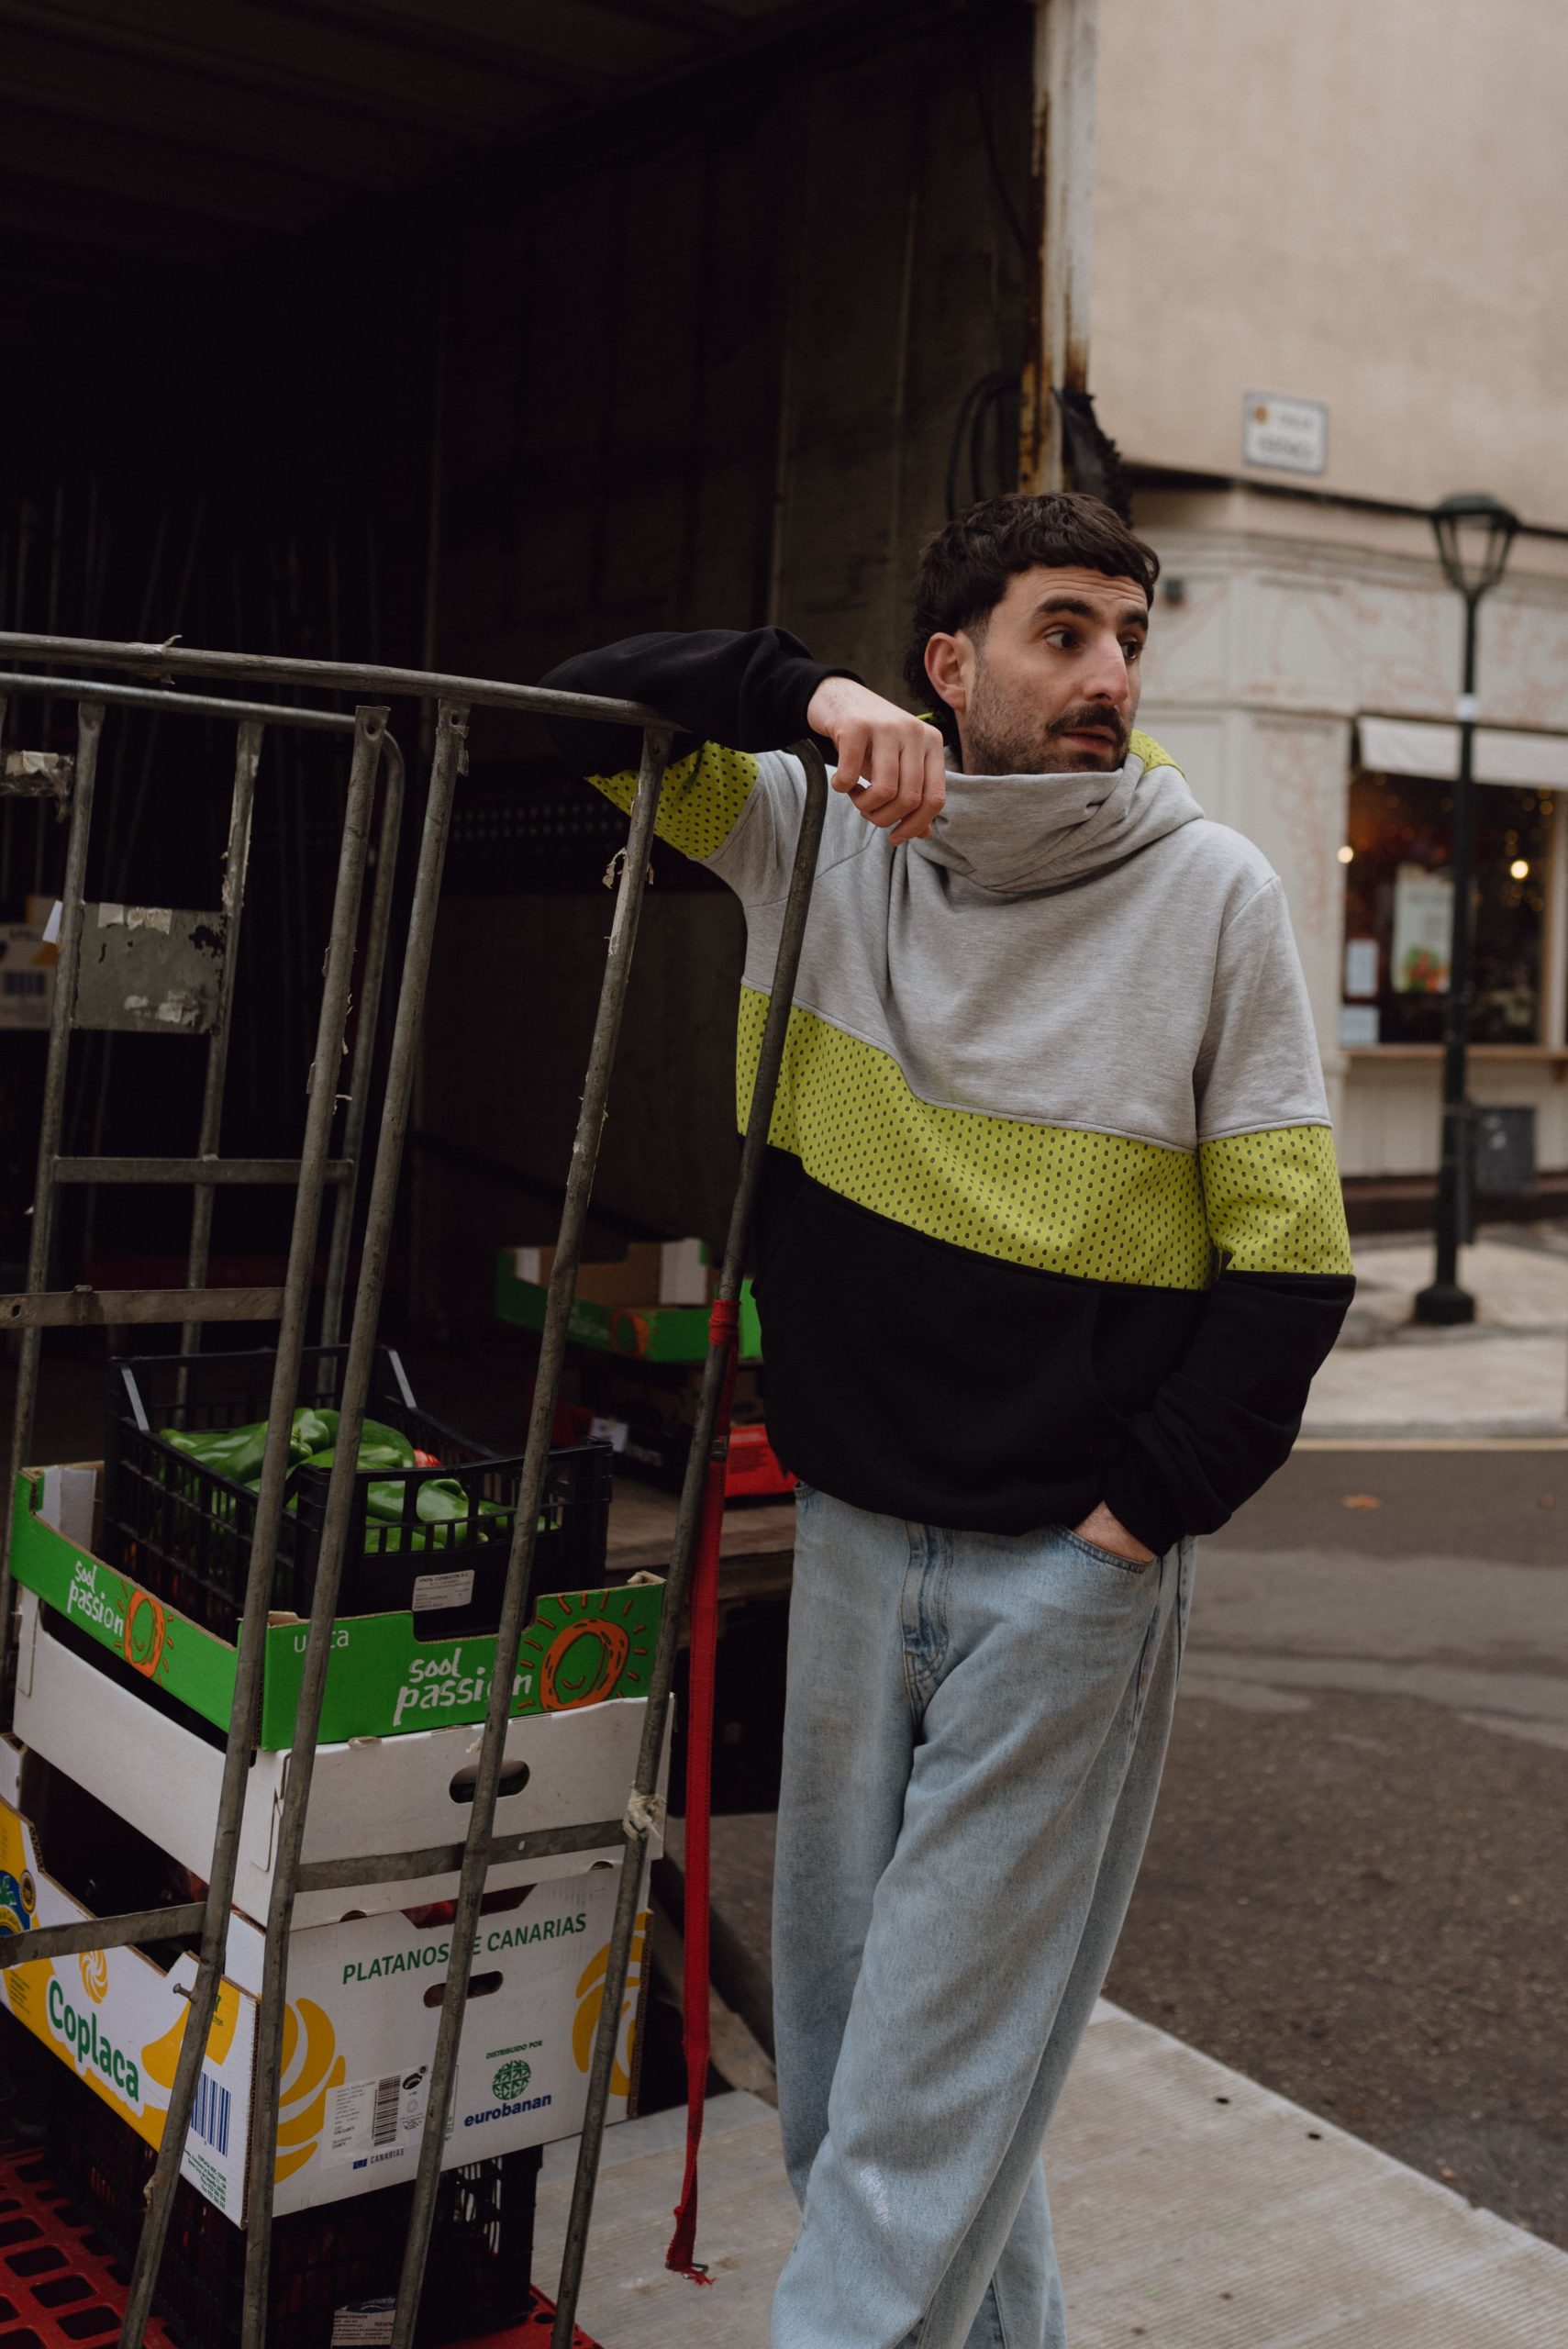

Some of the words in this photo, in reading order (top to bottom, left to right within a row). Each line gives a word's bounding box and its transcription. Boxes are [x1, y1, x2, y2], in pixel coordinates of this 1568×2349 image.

[74, 1559, 98, 1593] sool
[67, 1579, 125, 1637] passion
[409, 1648, 462, 1684] sool
[393, 1667, 532, 1727] passin
[342, 1943, 450, 1985] PLATANOS
[487, 1913, 586, 1952] CANARIAS
[50, 1980, 139, 2102] Coplaca
[486, 2044, 527, 2060] DISTRIBUIDO
[528, 2040, 543, 2049] POR
[464, 2095, 551, 2127] eurobanan
[371, 2148, 405, 2165] CANARIAS
